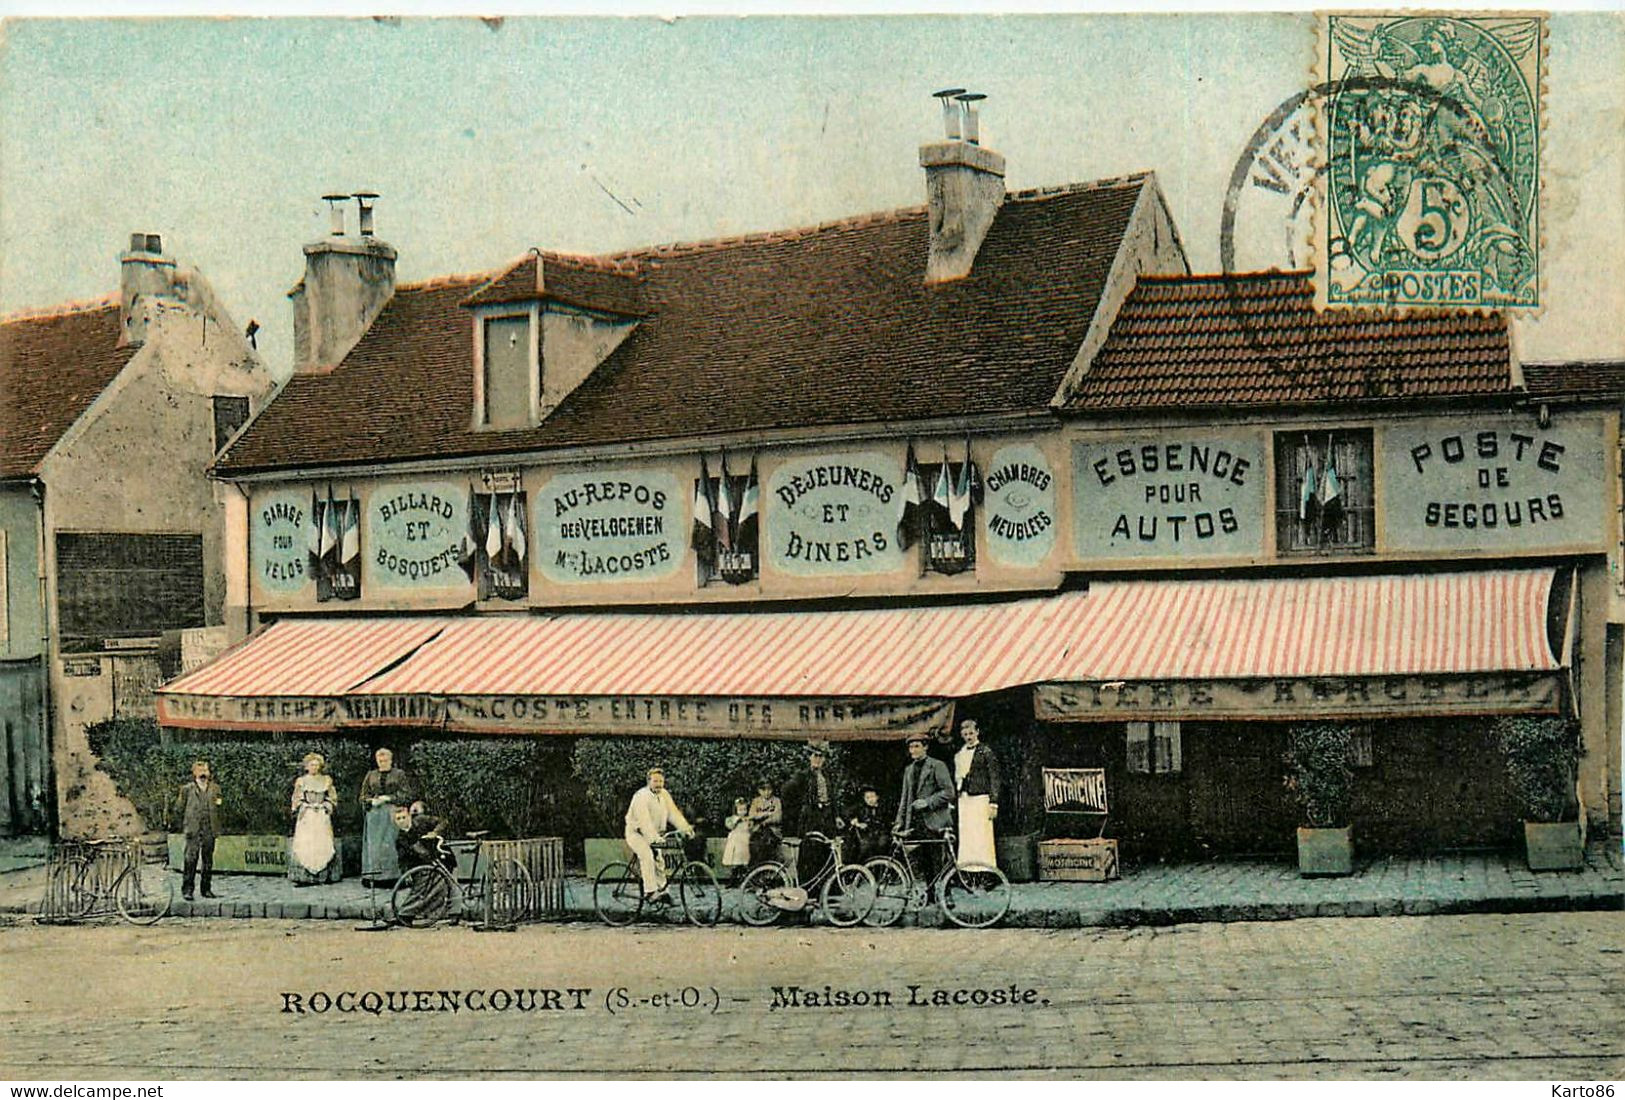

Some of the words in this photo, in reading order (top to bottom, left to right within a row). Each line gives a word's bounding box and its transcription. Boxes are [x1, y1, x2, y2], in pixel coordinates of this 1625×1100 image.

[1386, 274, 1478, 301] POSTES
[1093, 444, 1250, 487] ESSENCE
[1411, 431, 1565, 473] POSTE
[986, 463, 1051, 492] CHAMBRES
[1478, 467, 1510, 488] DE
[379, 493, 454, 520] BILLARD
[1145, 483, 1202, 503] POUR
[263, 503, 303, 528] GARAGE
[822, 503, 850, 523] ET
[1425, 493, 1564, 528] SECOURS
[405, 521, 431, 541] ET
[560, 522, 580, 539] DES
[1111, 507, 1239, 542] AUTOS
[273, 535, 293, 549] POUR
[784, 531, 888, 562] DINERS
[265, 558, 304, 581] VELOS
[376, 543, 461, 580] BOSQUETS
[579, 542, 671, 576] LACOSTE
[610, 700, 709, 723] ENTREE
[1044, 773, 1105, 810] MOTRICINE
